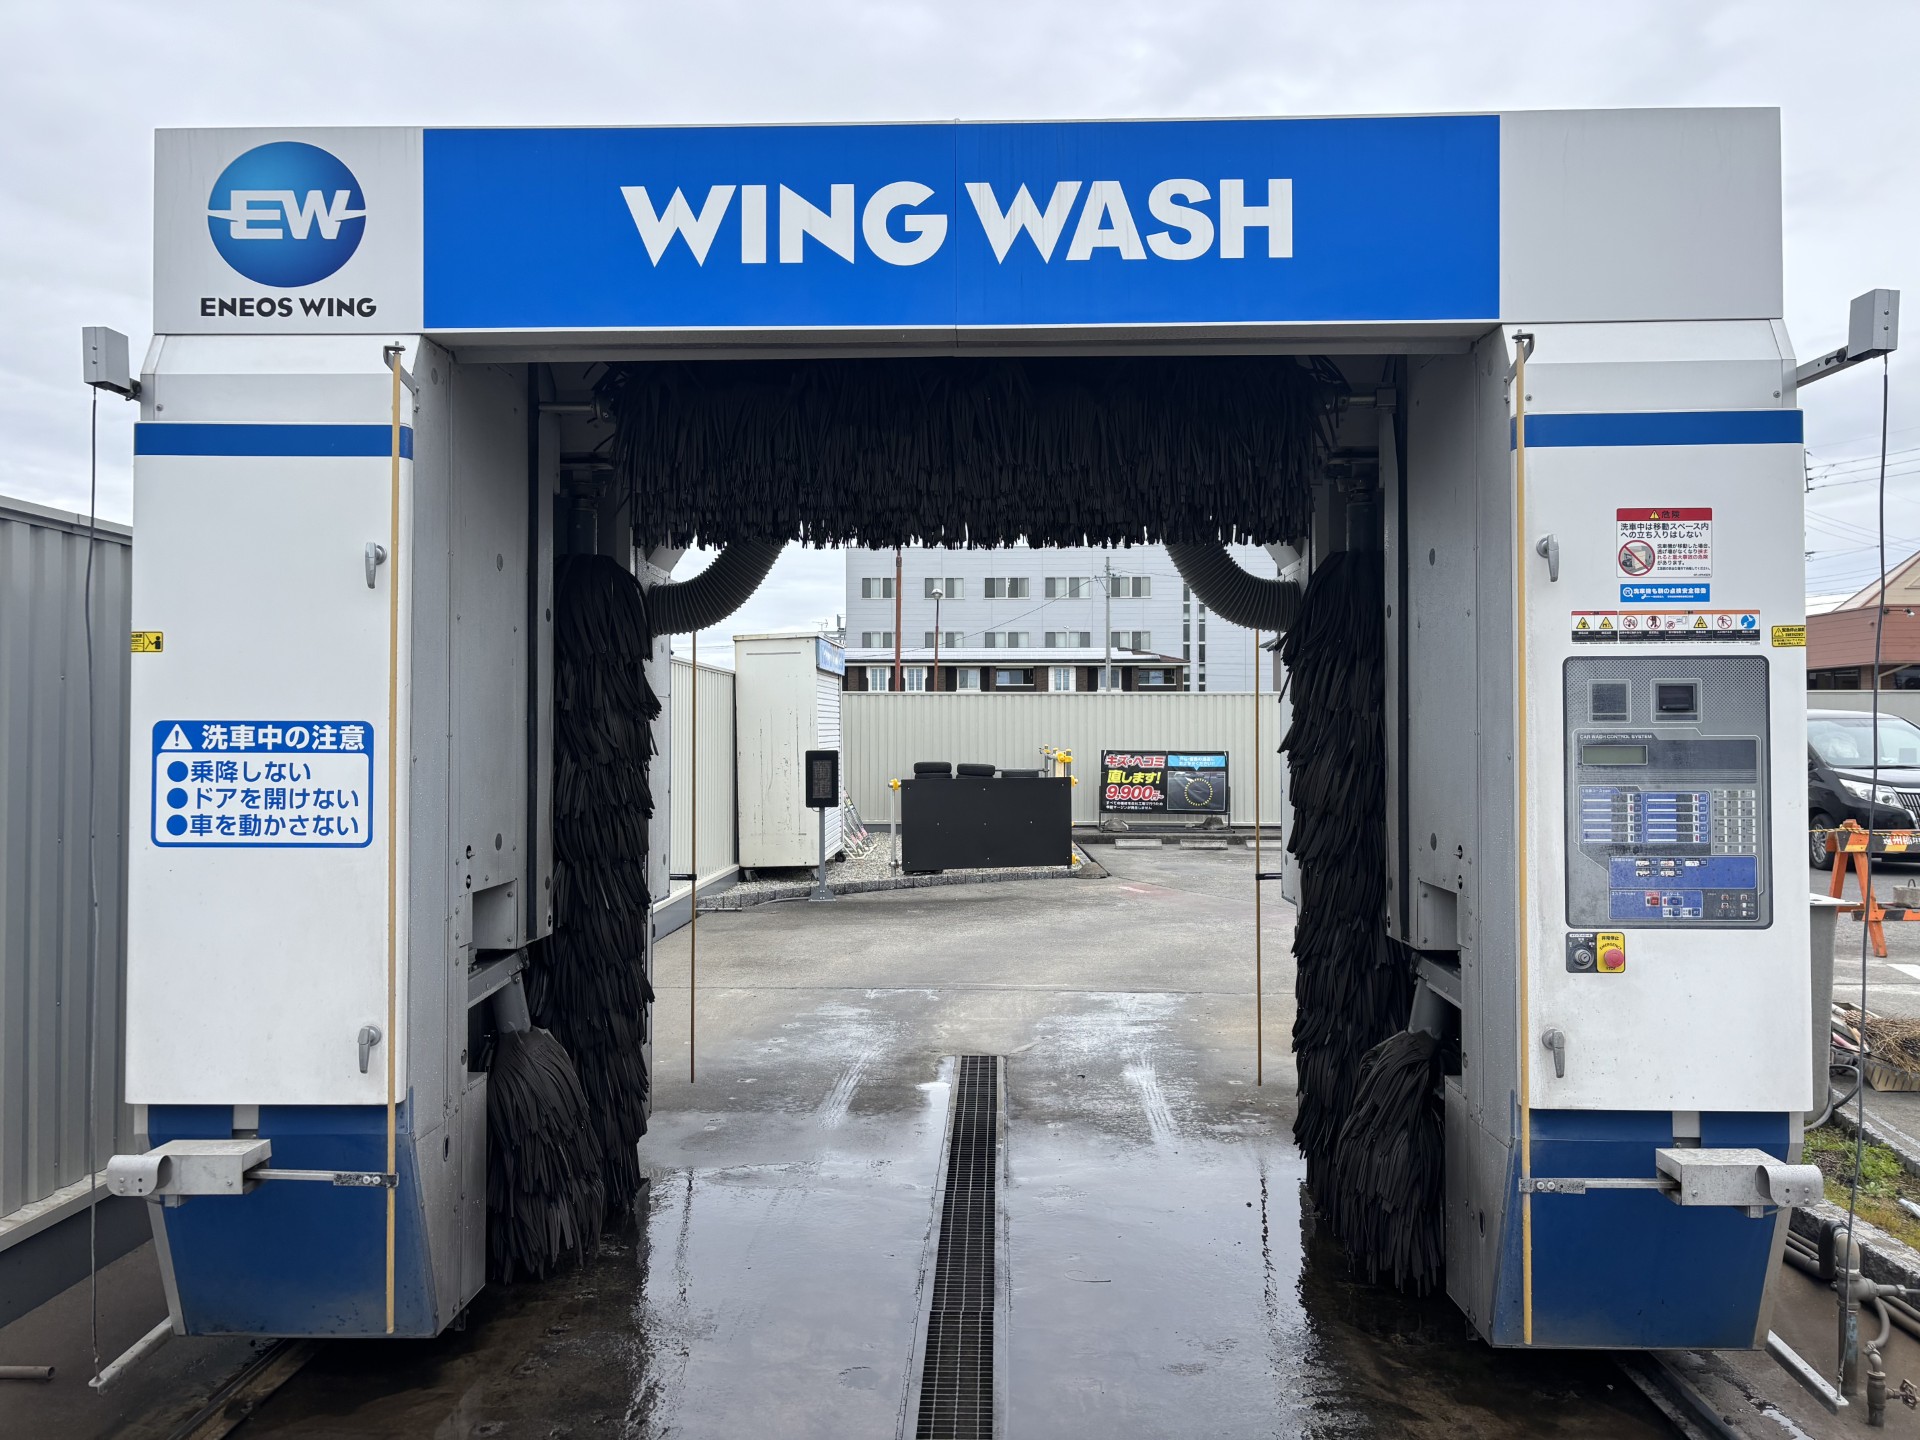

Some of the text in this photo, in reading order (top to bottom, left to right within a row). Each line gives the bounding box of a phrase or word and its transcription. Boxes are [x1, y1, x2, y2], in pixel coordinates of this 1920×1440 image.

[230, 189, 351, 239] EW
[621, 178, 1293, 267] WING WASH
[200, 297, 377, 318] ENEOS WING
[1661, 510, 1681, 519] 危険
[1620, 522, 1709, 531] 洗車中は移動スペース内
[1620, 531, 1703, 539] への立ち入りはしない
[201, 725, 365, 751] 洗車中の注意
[190, 760, 311, 783] 乗降しない
[1105, 754, 1166, 768] キズ・ヘコミ
[194, 788, 360, 810] ドアを開けない
[190, 813, 359, 837] 車を動かさない
[1599, 942, 1623, 951] EMERGENCY
